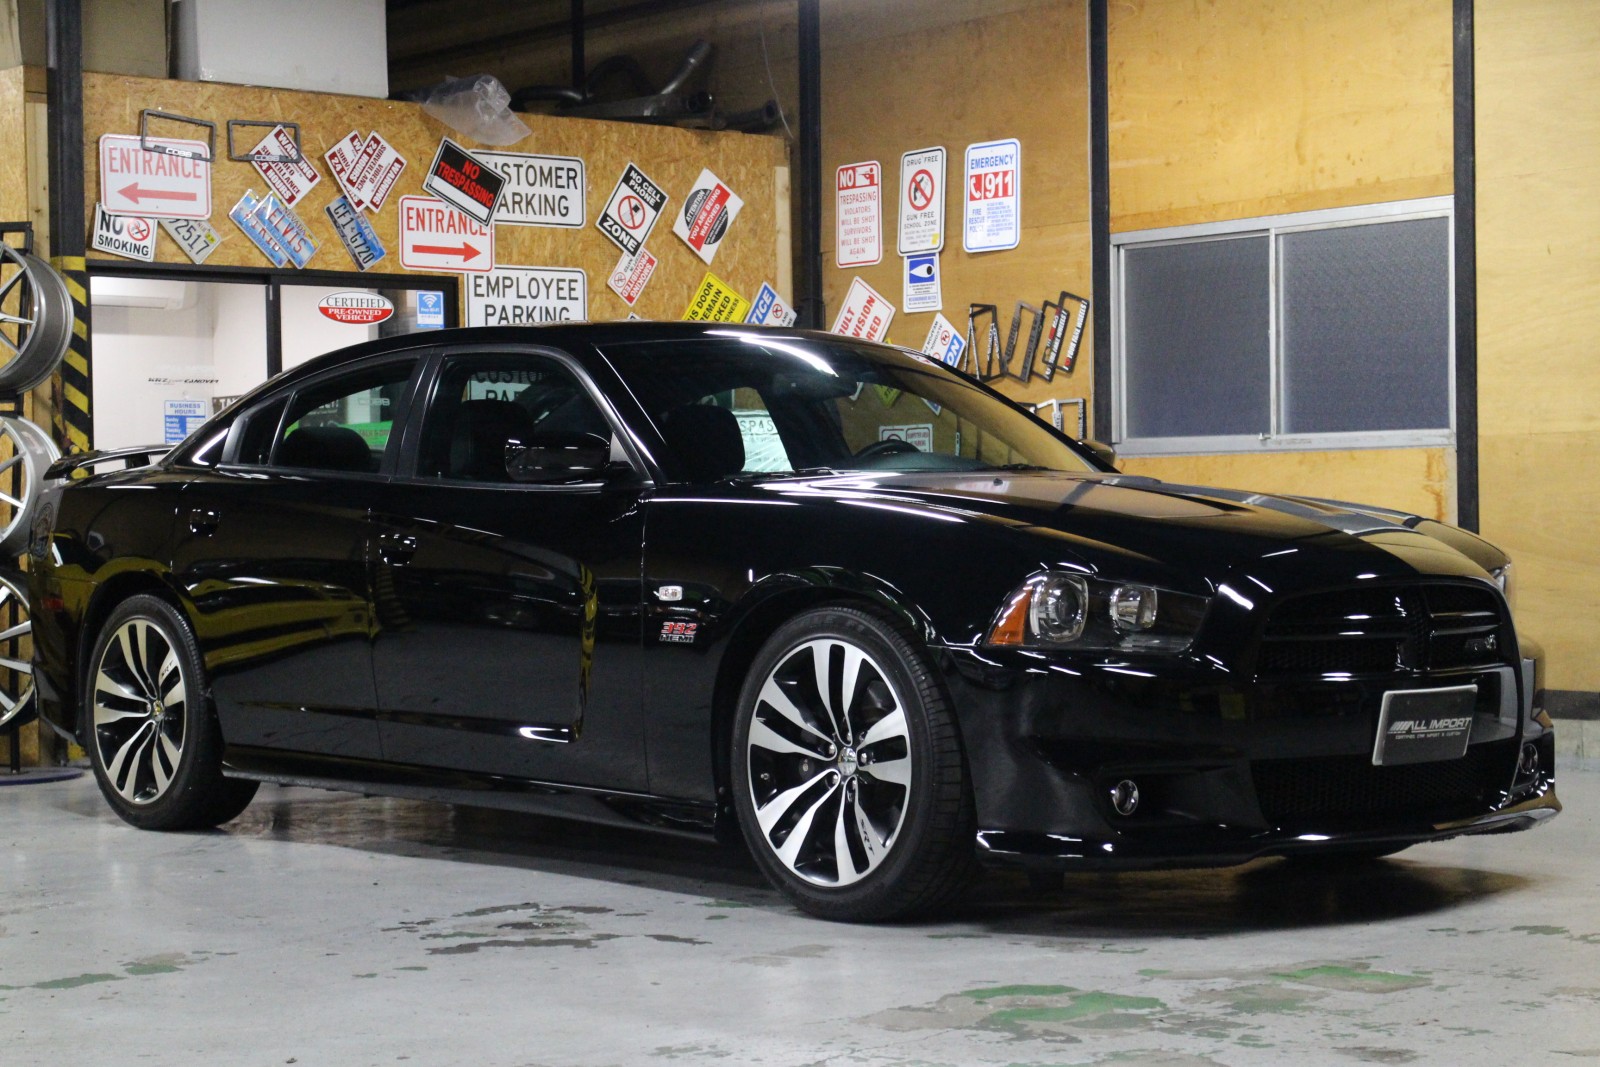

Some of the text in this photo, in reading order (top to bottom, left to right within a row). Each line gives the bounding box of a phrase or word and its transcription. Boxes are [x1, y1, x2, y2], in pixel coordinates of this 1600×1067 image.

[278, 132, 314, 179] WARING
[366, 140, 378, 154] 24
[108, 146, 202, 178] ENTRANCE
[350, 154, 370, 183] HOURS
[356, 144, 386, 192] SURVEILLANCE
[463, 160, 480, 178] NO
[906, 155, 938, 166] DRUG FREE
[970, 154, 1014, 170] EMERGENCY
[266, 168, 291, 200] HOURS
[369, 164, 384, 184] VIDEO
[372, 162, 401, 206] WARNING
[438, 161, 494, 208] TRESPASSING
[494, 162, 578, 190] STOMER
[630, 170, 661, 202] NO CELL
[840, 169, 854, 188] NO
[985, 170, 1012, 199] 911
[499, 192, 569, 217] ARKING
[629, 180, 656, 206] PHONE
[840, 191, 876, 205] TRESPASSING
[686, 190, 706, 222] ATTENTION
[690, 226, 700, 240] YOU
[698, 210, 708, 226] ARE
[706, 188, 720, 211] BEING
[844, 206, 872, 215] VIOLATORS
[100, 211, 124, 236] NO
[268, 208, 307, 254] ELVIS
[700, 204, 720, 236] WATCHED
[841, 218, 852, 226] WILL
[862, 216, 875, 224] SHOT
[844, 226, 872, 236] SURVIVORS
[904, 222, 922, 230] SCHOOL
[98, 234, 150, 256] SMOKING
[334, 202, 356, 230] CF1
[350, 231, 376, 264] G720
[602, 216, 638, 252] ZONE
[841, 238, 852, 246] WILL
[862, 236, 876, 244] SHOT
[850, 247, 866, 255] AGAIN
[622, 253, 650, 297] PROHIBITED
[630, 263, 652, 298] SMOKING
[474, 275, 579, 301] EMPLOYEE
[696, 282, 714, 309] DOOR
[326, 297, 386, 308] CERTIFIED
[485, 304, 570, 326] PARKING
[713, 295, 730, 322] CKED
[724, 298, 739, 322] SINESS
[751, 290, 772, 324] TICE
[852, 296, 876, 337] VISION
[866, 316, 882, 341] RED
[1067, 342, 1078, 359] YOUR
[476, 371, 542, 384] CUSTO
[740, 420, 774, 432] SPAS
[661, 622, 697, 634] 392
[1429, 716, 1473, 730] IMPORT
